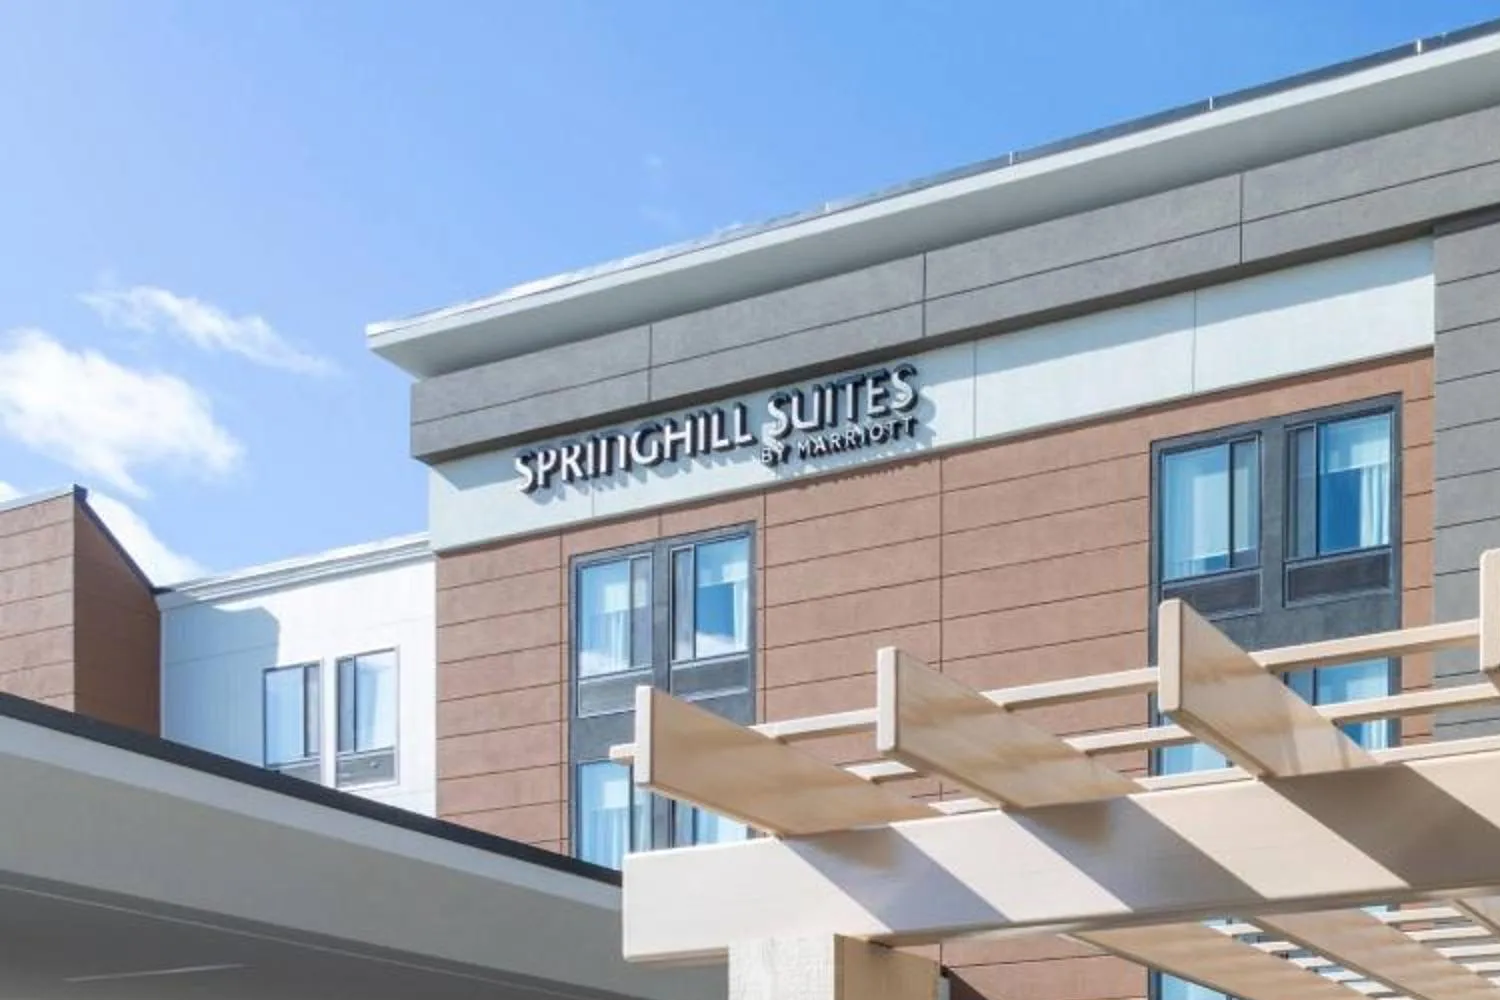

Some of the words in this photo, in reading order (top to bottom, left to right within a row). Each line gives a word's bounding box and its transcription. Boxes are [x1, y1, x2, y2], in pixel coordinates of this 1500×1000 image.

[513, 400, 757, 493] SPRINGHILL
[766, 362, 918, 438] SUITES
[760, 439, 789, 467] BY
[797, 414, 918, 461] MARRIOTT
